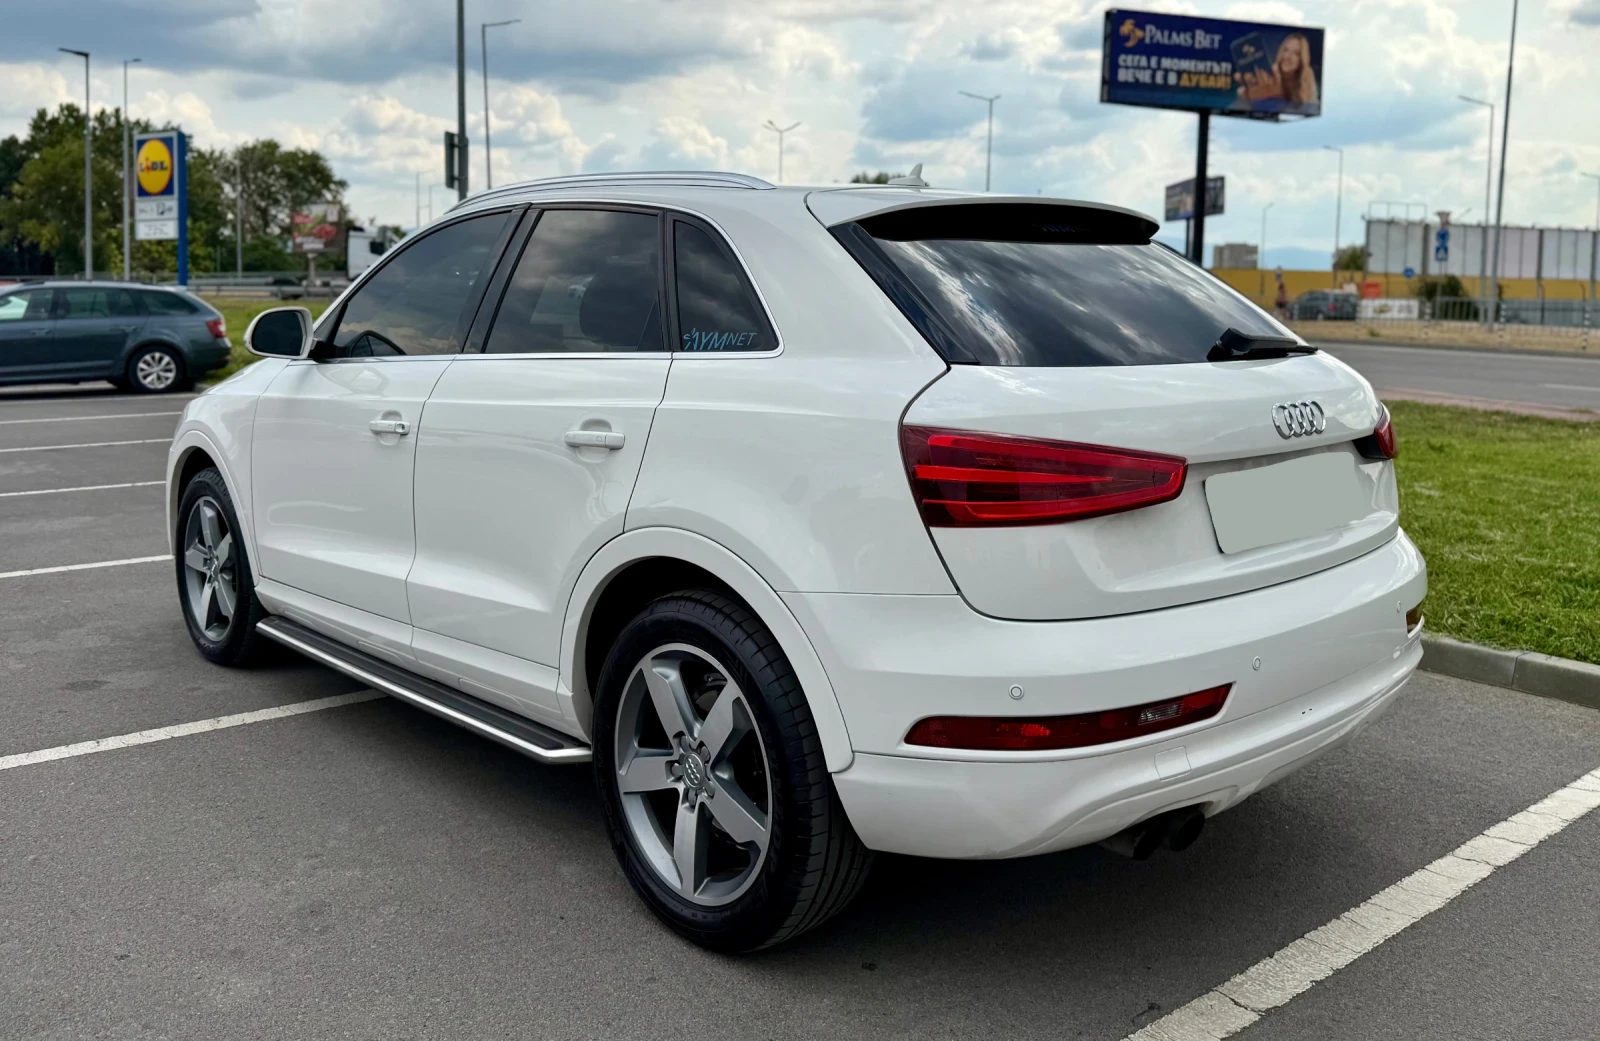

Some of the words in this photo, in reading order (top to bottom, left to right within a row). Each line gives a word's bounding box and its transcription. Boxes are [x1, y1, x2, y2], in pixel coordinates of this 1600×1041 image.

[1144, 24, 1193, 47] PALMS
[1194, 28, 1223, 49] BET
[1118, 54, 1148, 68] СЕГА
